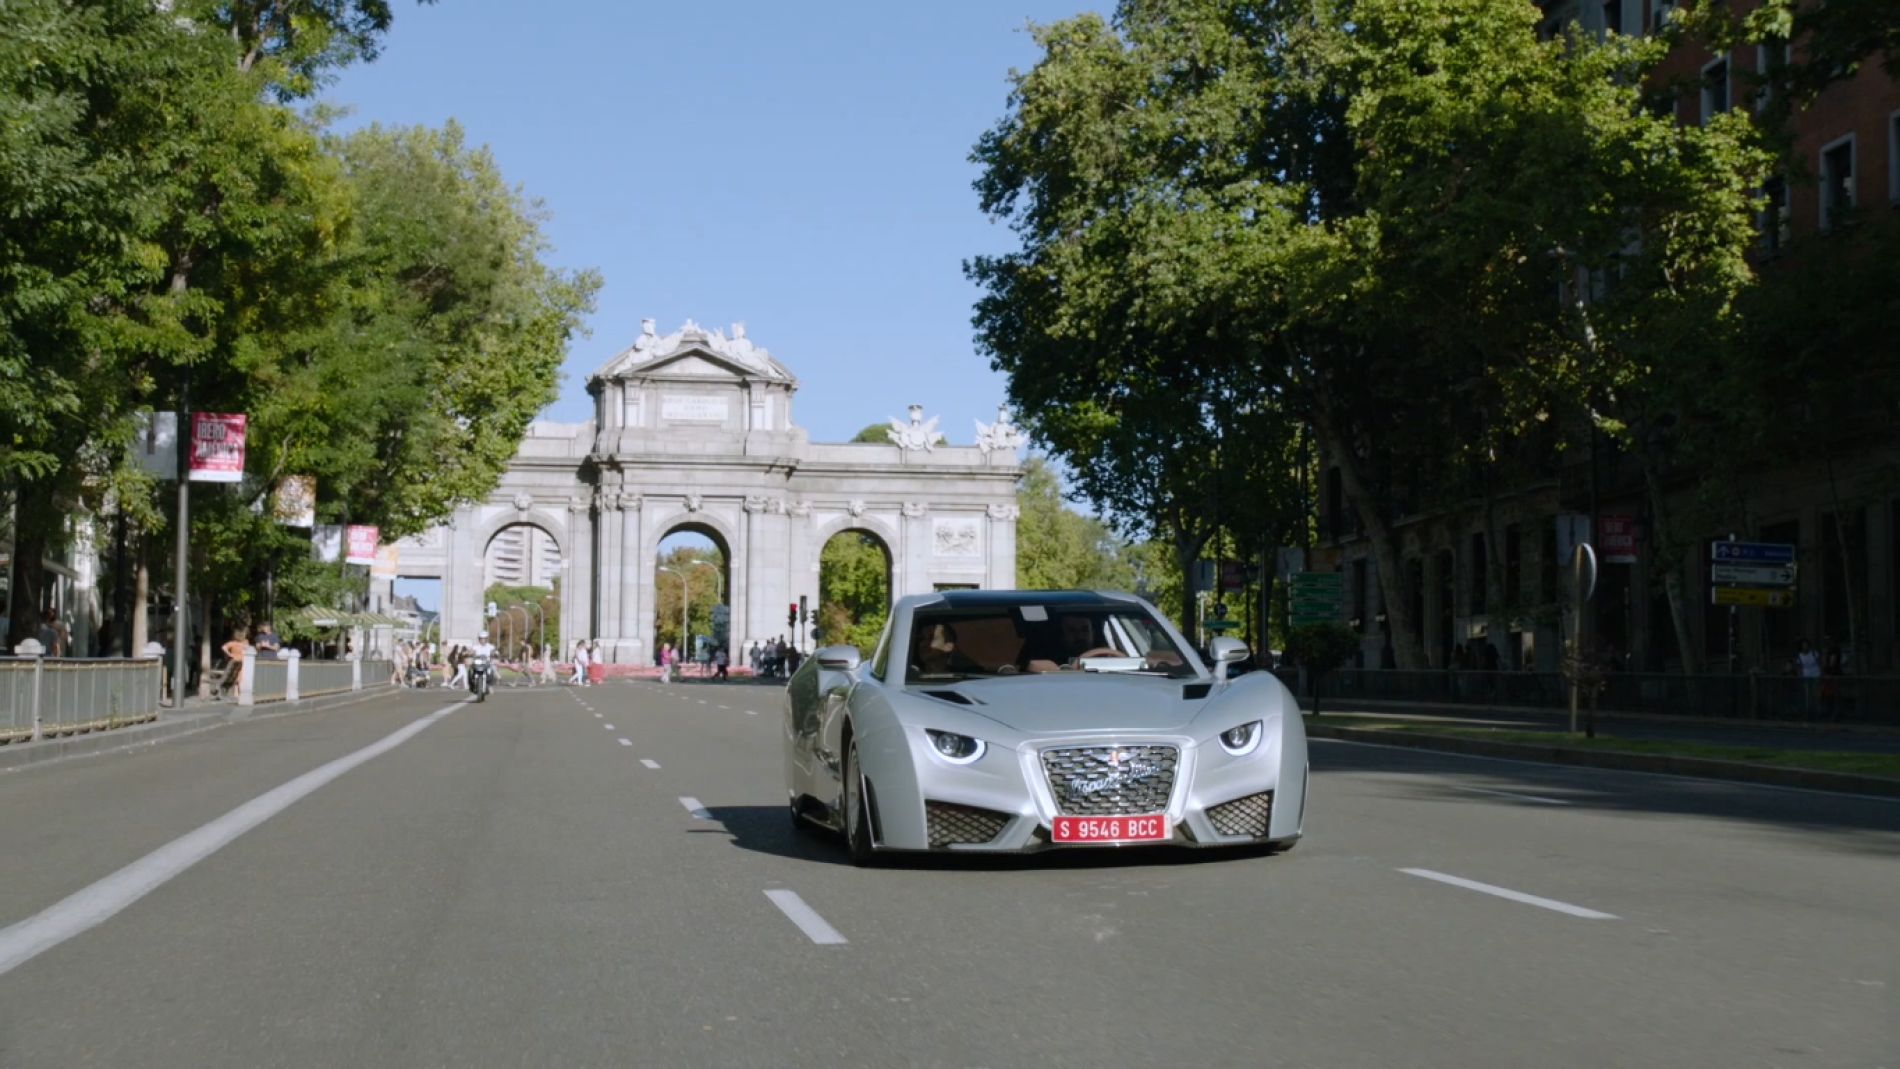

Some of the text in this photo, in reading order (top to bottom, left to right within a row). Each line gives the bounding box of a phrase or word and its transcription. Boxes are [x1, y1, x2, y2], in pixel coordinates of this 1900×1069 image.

[1060, 819, 1158, 838] S 9546 BCC
